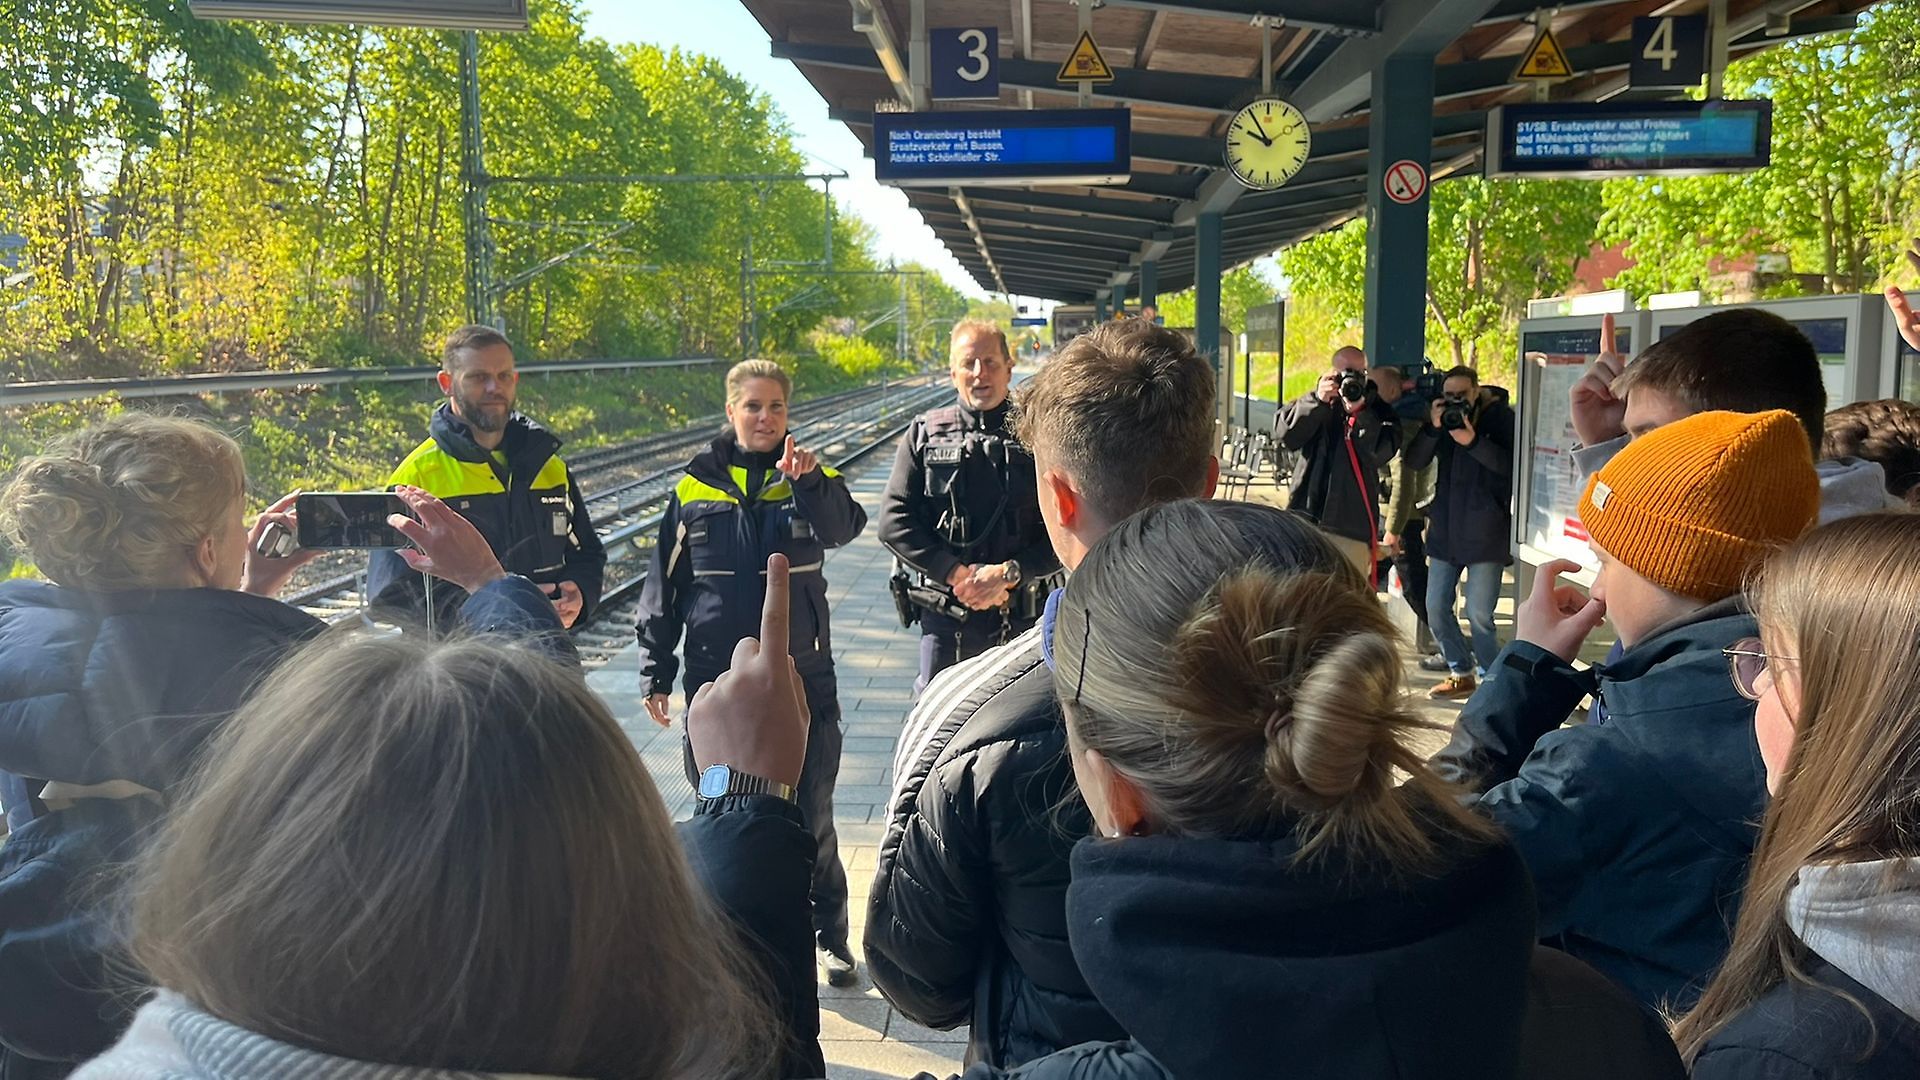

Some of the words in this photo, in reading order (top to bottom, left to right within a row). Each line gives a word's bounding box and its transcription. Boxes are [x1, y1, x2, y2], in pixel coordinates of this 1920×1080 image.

[1643, 16, 1678, 71] 4
[956, 28, 990, 82] 3
[889, 130, 911, 140] Nach
[913, 130, 965, 141] Oranienburg
[966, 129, 1002, 139] besteht
[1516, 133, 1533, 144] und
[889, 141, 951, 151] Ersatzverkehr
[953, 141, 968, 151] mit
[970, 140, 1004, 151] Bussen.
[1515, 144, 1533, 156] Bus
[984, 151, 1001, 162] Str.
